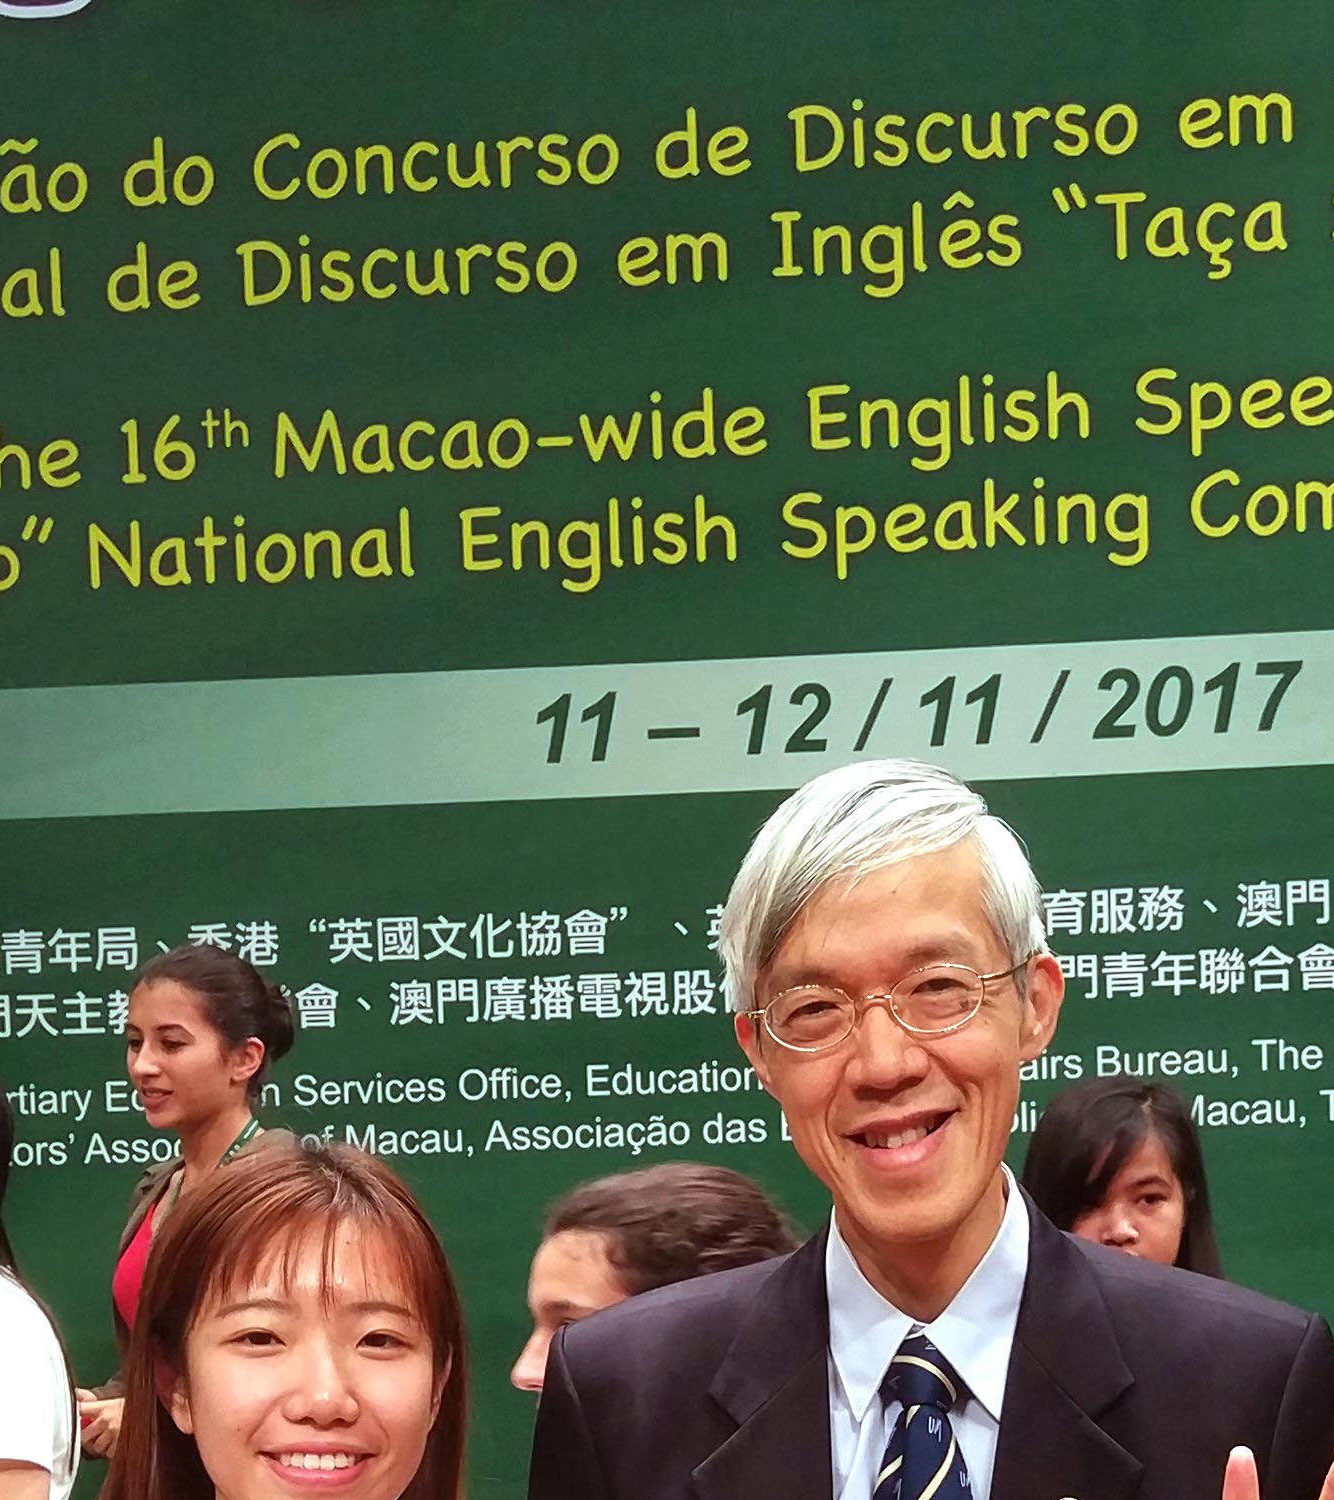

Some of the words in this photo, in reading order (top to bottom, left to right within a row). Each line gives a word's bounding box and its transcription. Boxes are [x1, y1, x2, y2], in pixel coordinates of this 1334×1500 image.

[122, 134, 216, 208] do
[252, 131, 621, 202] Concurso
[654, 105, 753, 180] de
[787, 100, 1140, 174] Discurso
[1177, 91, 1295, 150] em
[105, 240, 202, 314] de
[234, 234, 579, 307] Discurso
[616, 230, 729, 288] em
[769, 189, 1023, 299] Inglês
[273, 386, 768, 480] Macao-wide
[805, 370, 1091, 473] English
[87, 507, 415, 590] National
[457, 493, 739, 594] English
[781, 478, 1151, 582] Speaking
[535, 691, 618, 764] 11
[735, 682, 833, 756] 12
[918, 673, 1005, 748] 11
[1091, 659, 1305, 741] 2017
[6, 1083, 92, 1122] rtiary
[293, 1071, 447, 1107] Services
[458, 1066, 572, 1104] Office,
[585, 1059, 765, 1098] Education
[1018, 1048, 1084, 1082] airs
[1095, 1044, 1239, 1079] Bureau,
[1251, 1038, 1324, 1072] The
[300, 1124, 336, 1154] of
[344, 1123, 474, 1158] Macau,
[484, 1114, 691, 1156] Associação
[702, 1111, 768, 1145] das
